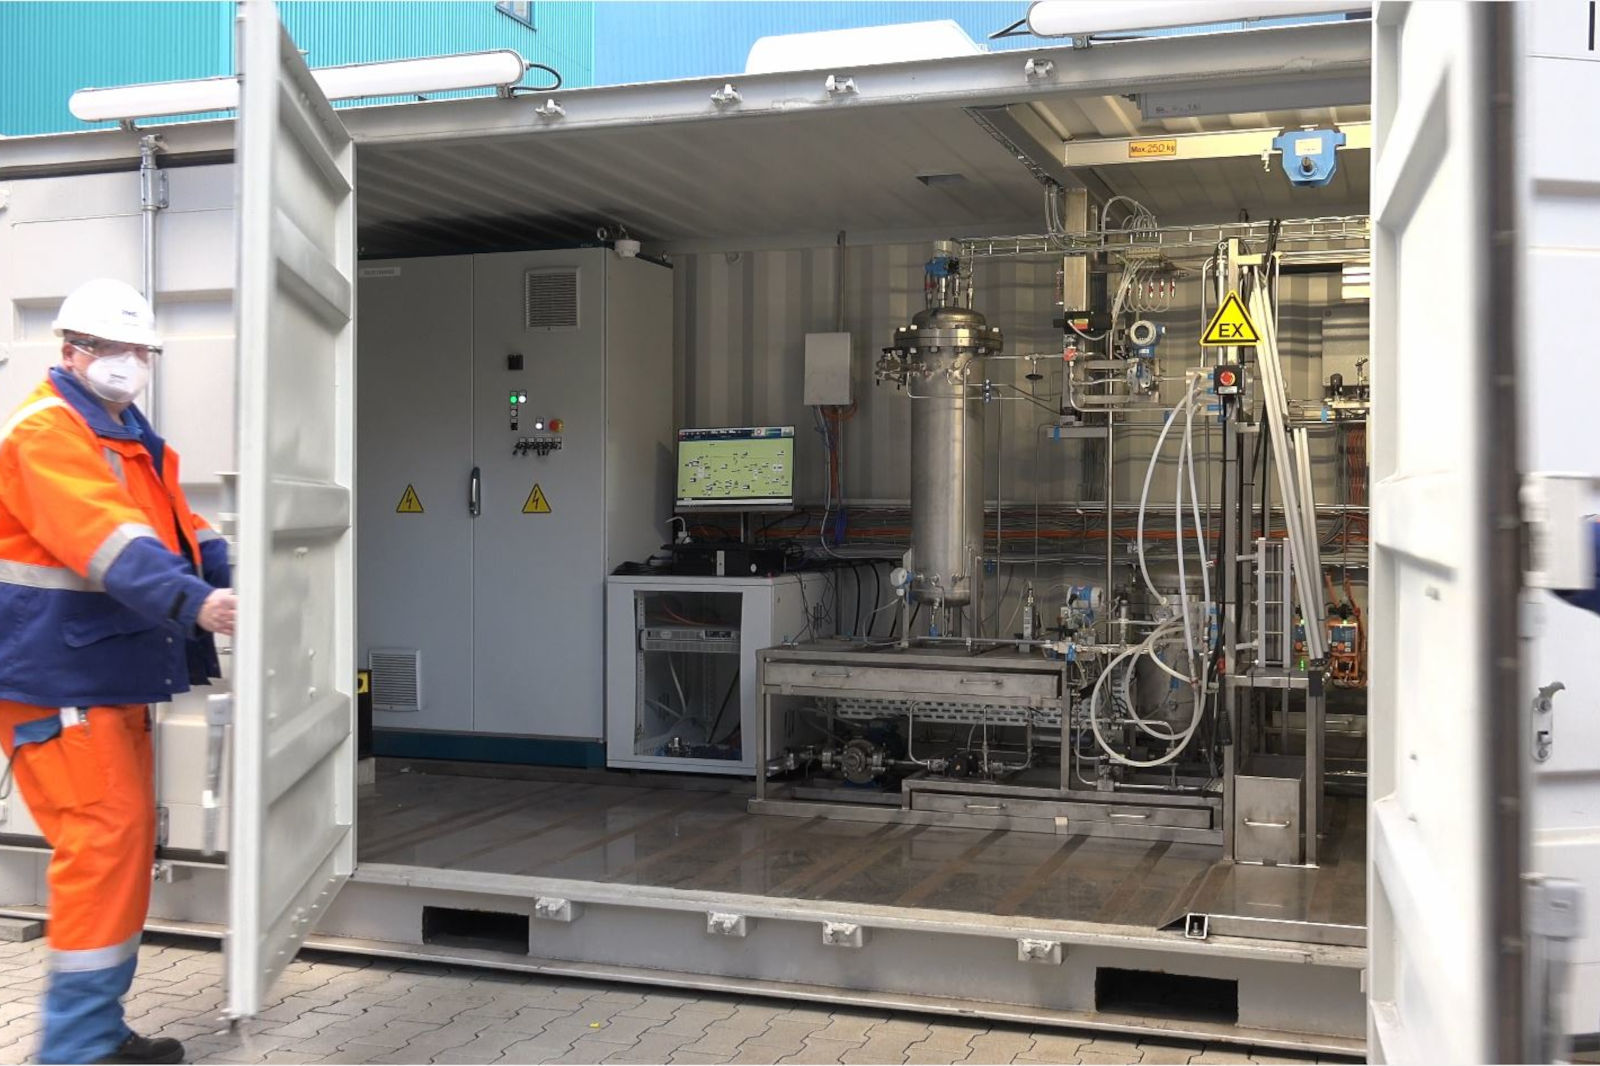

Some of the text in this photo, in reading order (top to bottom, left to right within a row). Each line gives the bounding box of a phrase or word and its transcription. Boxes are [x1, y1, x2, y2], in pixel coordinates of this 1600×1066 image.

[1147, 143, 1165, 153] 250
[1166, 143, 1175, 153] kg
[1219, 323, 1244, 338] EX
